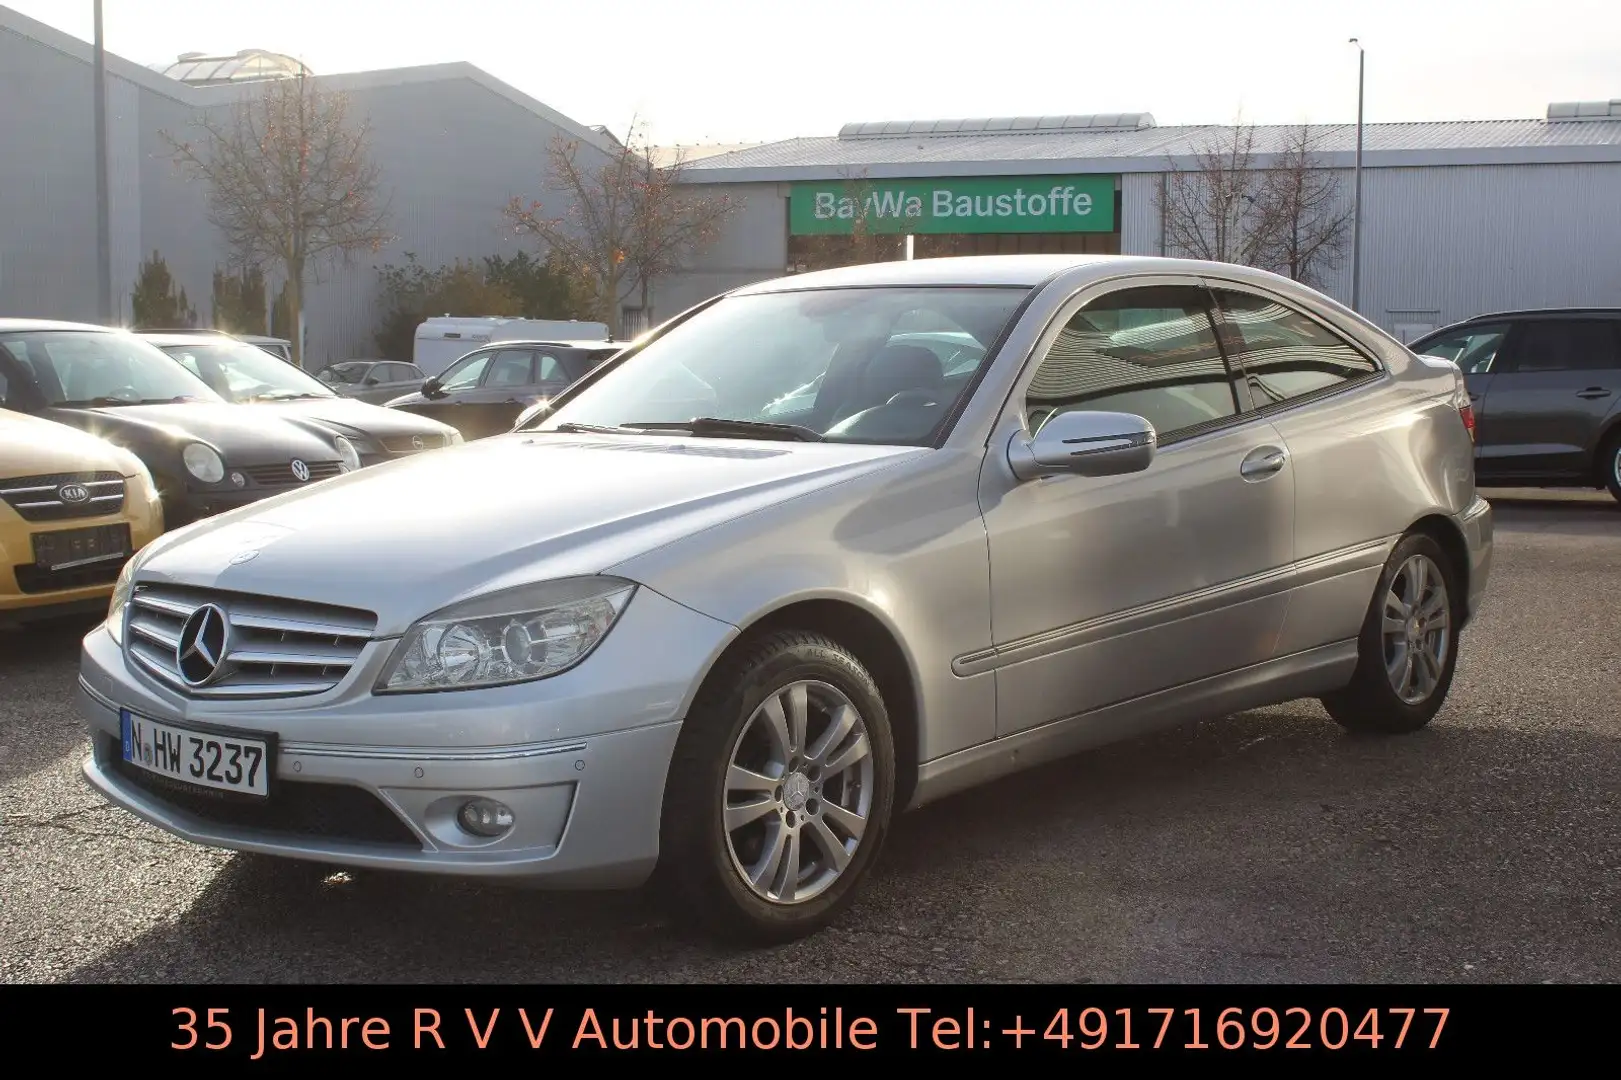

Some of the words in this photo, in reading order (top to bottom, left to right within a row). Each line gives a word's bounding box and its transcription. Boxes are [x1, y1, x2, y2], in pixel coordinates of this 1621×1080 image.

[814, 190, 922, 220] BayWa
[932, 186, 1093, 218] Baustoffe
[63, 488, 86, 499] KIA
[131, 719, 143, 762] N
[153, 727, 182, 774] HW
[189, 736, 263, 788] 3237
